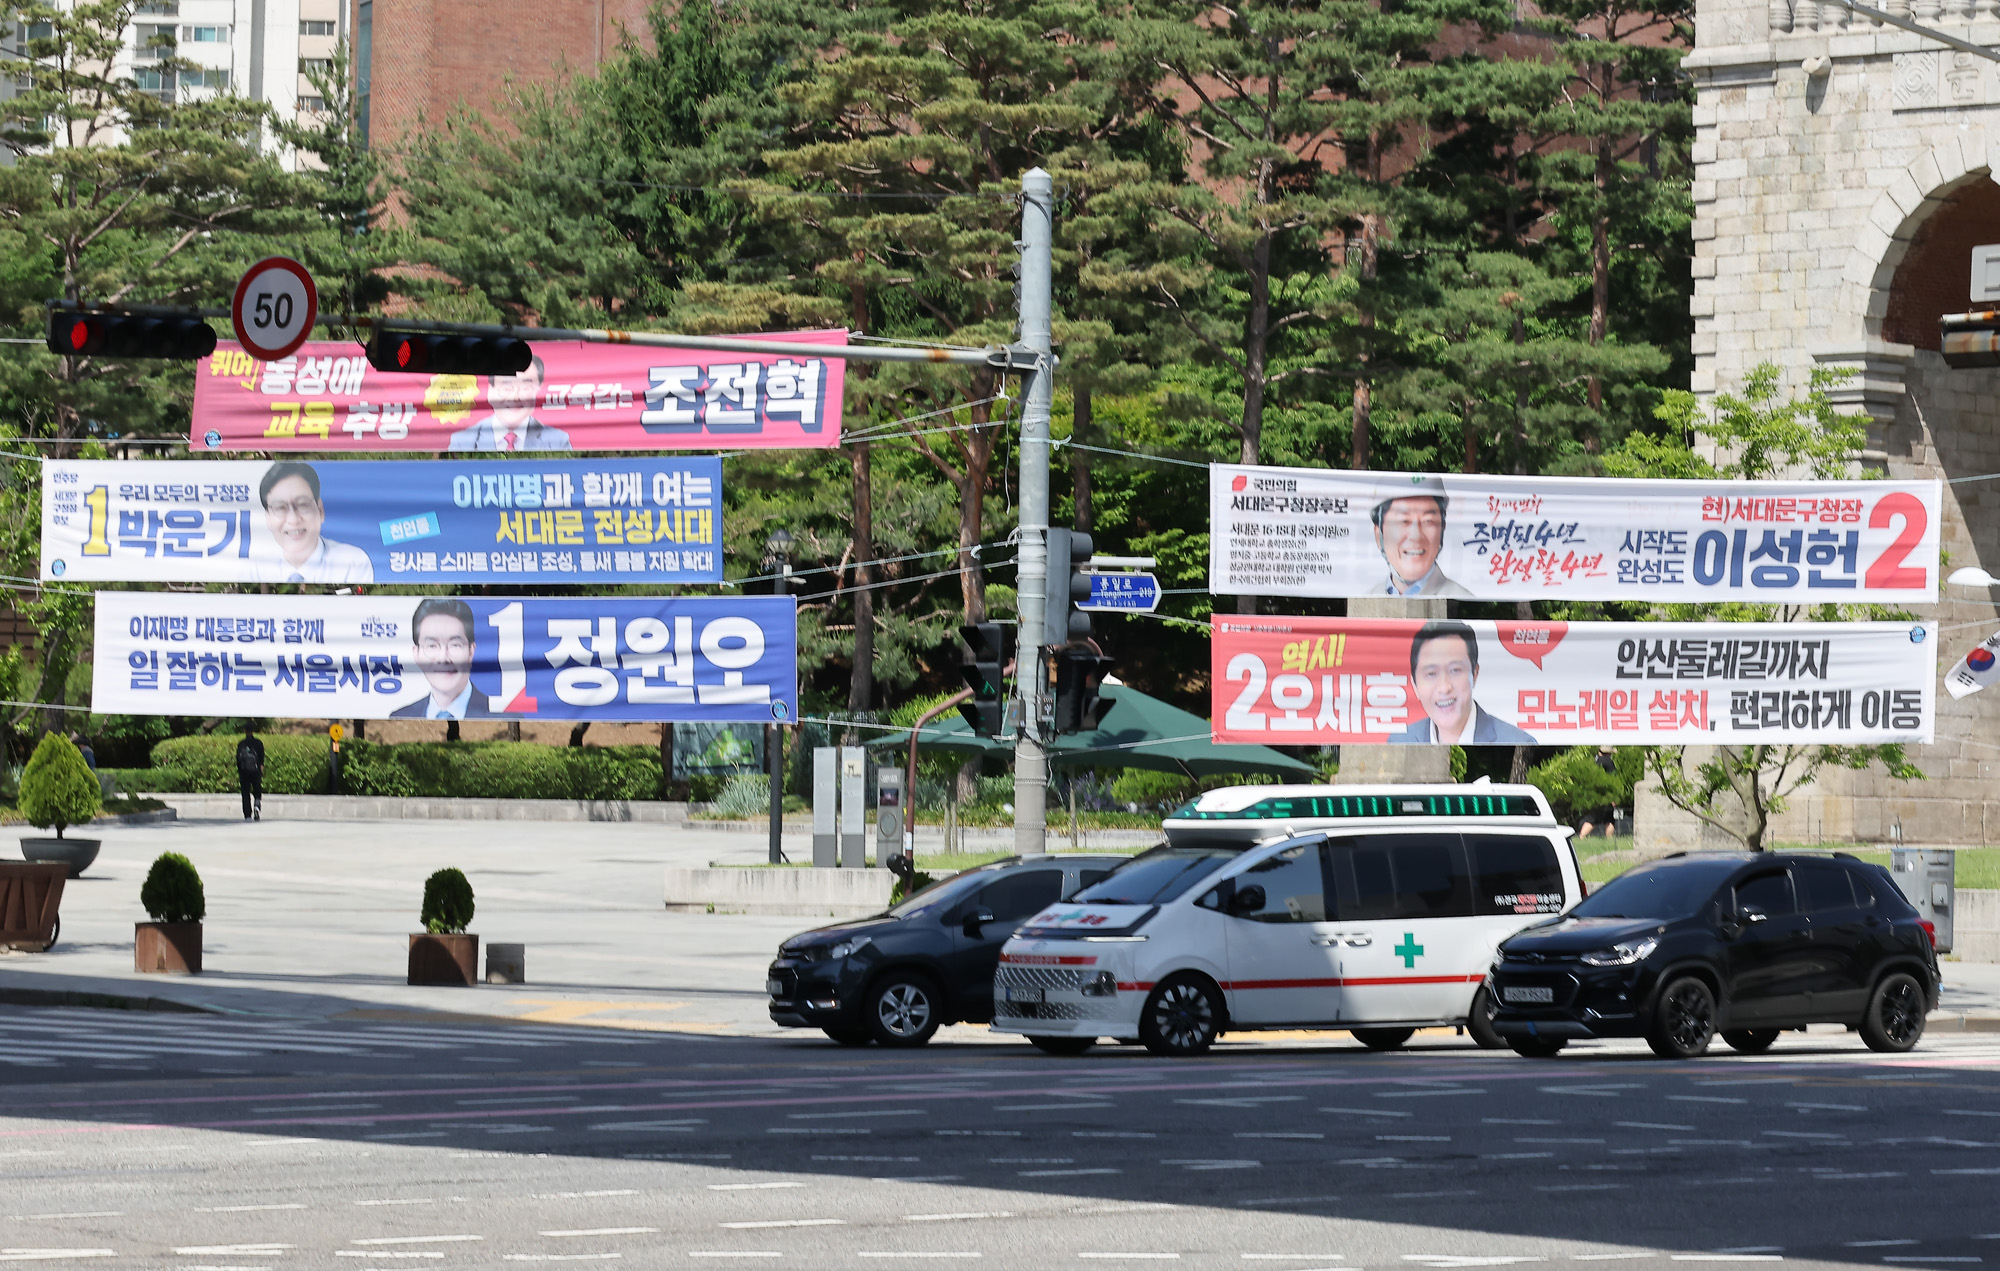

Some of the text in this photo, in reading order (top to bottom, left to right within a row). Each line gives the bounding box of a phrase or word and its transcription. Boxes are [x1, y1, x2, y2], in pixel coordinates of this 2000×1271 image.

[254, 293, 294, 329] 50
[260, 356, 367, 395] 동성애
[641, 359, 826, 432] 조전혁
[264, 401, 417, 440] 교육 추방
[119, 484, 250, 502] 우리 모두의 구청장
[453, 471, 712, 509] 이재명과 함께 여는
[1253, 478, 1297, 492] 국민의힘
[81, 485, 111, 557] 1
[1230, 496, 1348, 514] 서대문구청장후보
[1702, 495, 1863, 524] 현)서대문구청장
[118, 510, 251, 559] 박운기
[496, 508, 713, 545] 서대문 전성시대
[1619, 530, 1687, 556] 시작도
[1865, 492, 1928, 589] 2
[389, 551, 438, 573] 경사로
[440, 551, 489, 573] 스마트
[490, 551, 539, 573] 안심길
[541, 551, 578, 574] 조성,
[649, 551, 681, 572] 지원
[682, 550, 713, 572] 확대
[1617, 559, 1684, 585] 완성도
[1692, 528, 1859, 588] 이성헌
[130, 615, 325, 644] 이재명 대통령과 함께
[361, 620, 399, 639] 민주당
[128, 650, 404, 694] 일 잘하는 서울시장
[488, 601, 538, 713] 1
[544, 616, 771, 706] 정원오
[1282, 633, 1346, 674] 역시!
[1616, 639, 1830, 680] 안산둘레길까지
[1225, 653, 1268, 731] 2
[1268, 672, 1408, 734] 오세훈
[1517, 689, 1921, 732] 모노레일 설치, 편리하게 이동
